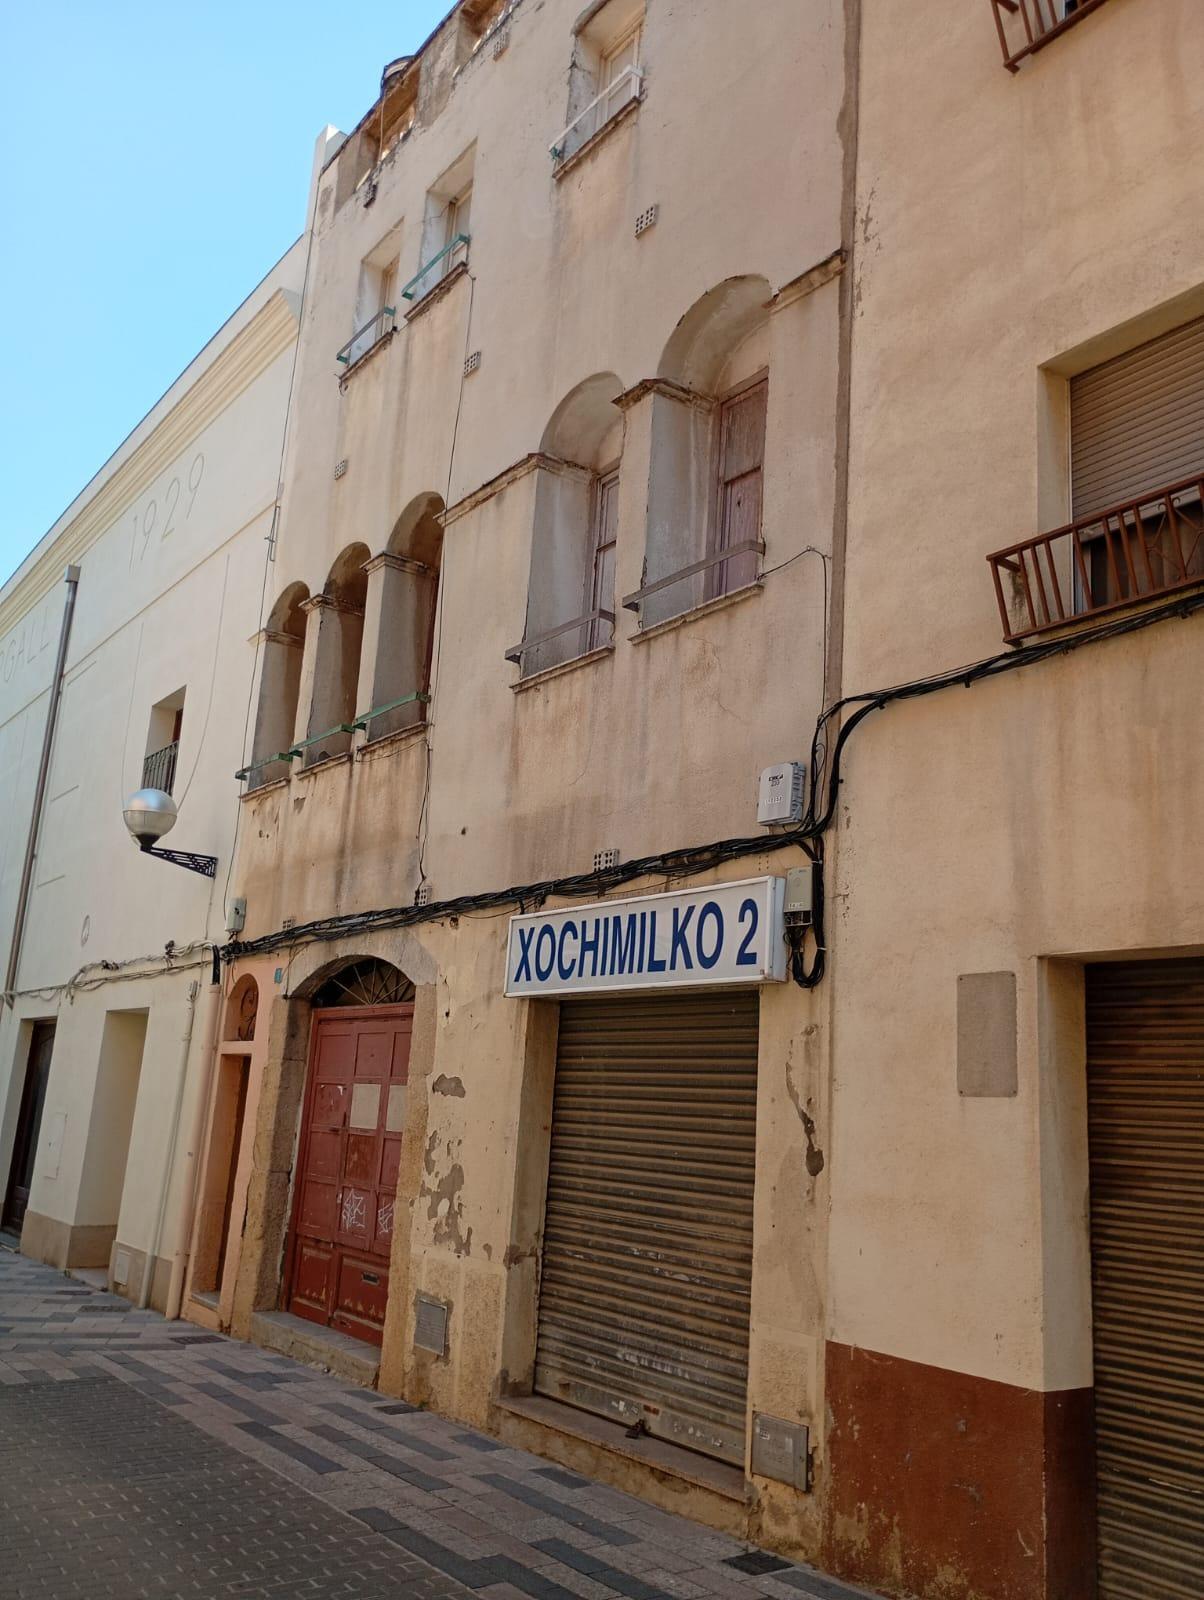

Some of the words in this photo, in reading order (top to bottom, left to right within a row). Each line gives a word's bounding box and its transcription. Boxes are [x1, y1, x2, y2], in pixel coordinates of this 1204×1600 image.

[128, 451, 205, 575] 1929
[513, 901, 725, 983] XOCHIMILKO
[736, 898, 759, 966] 2
